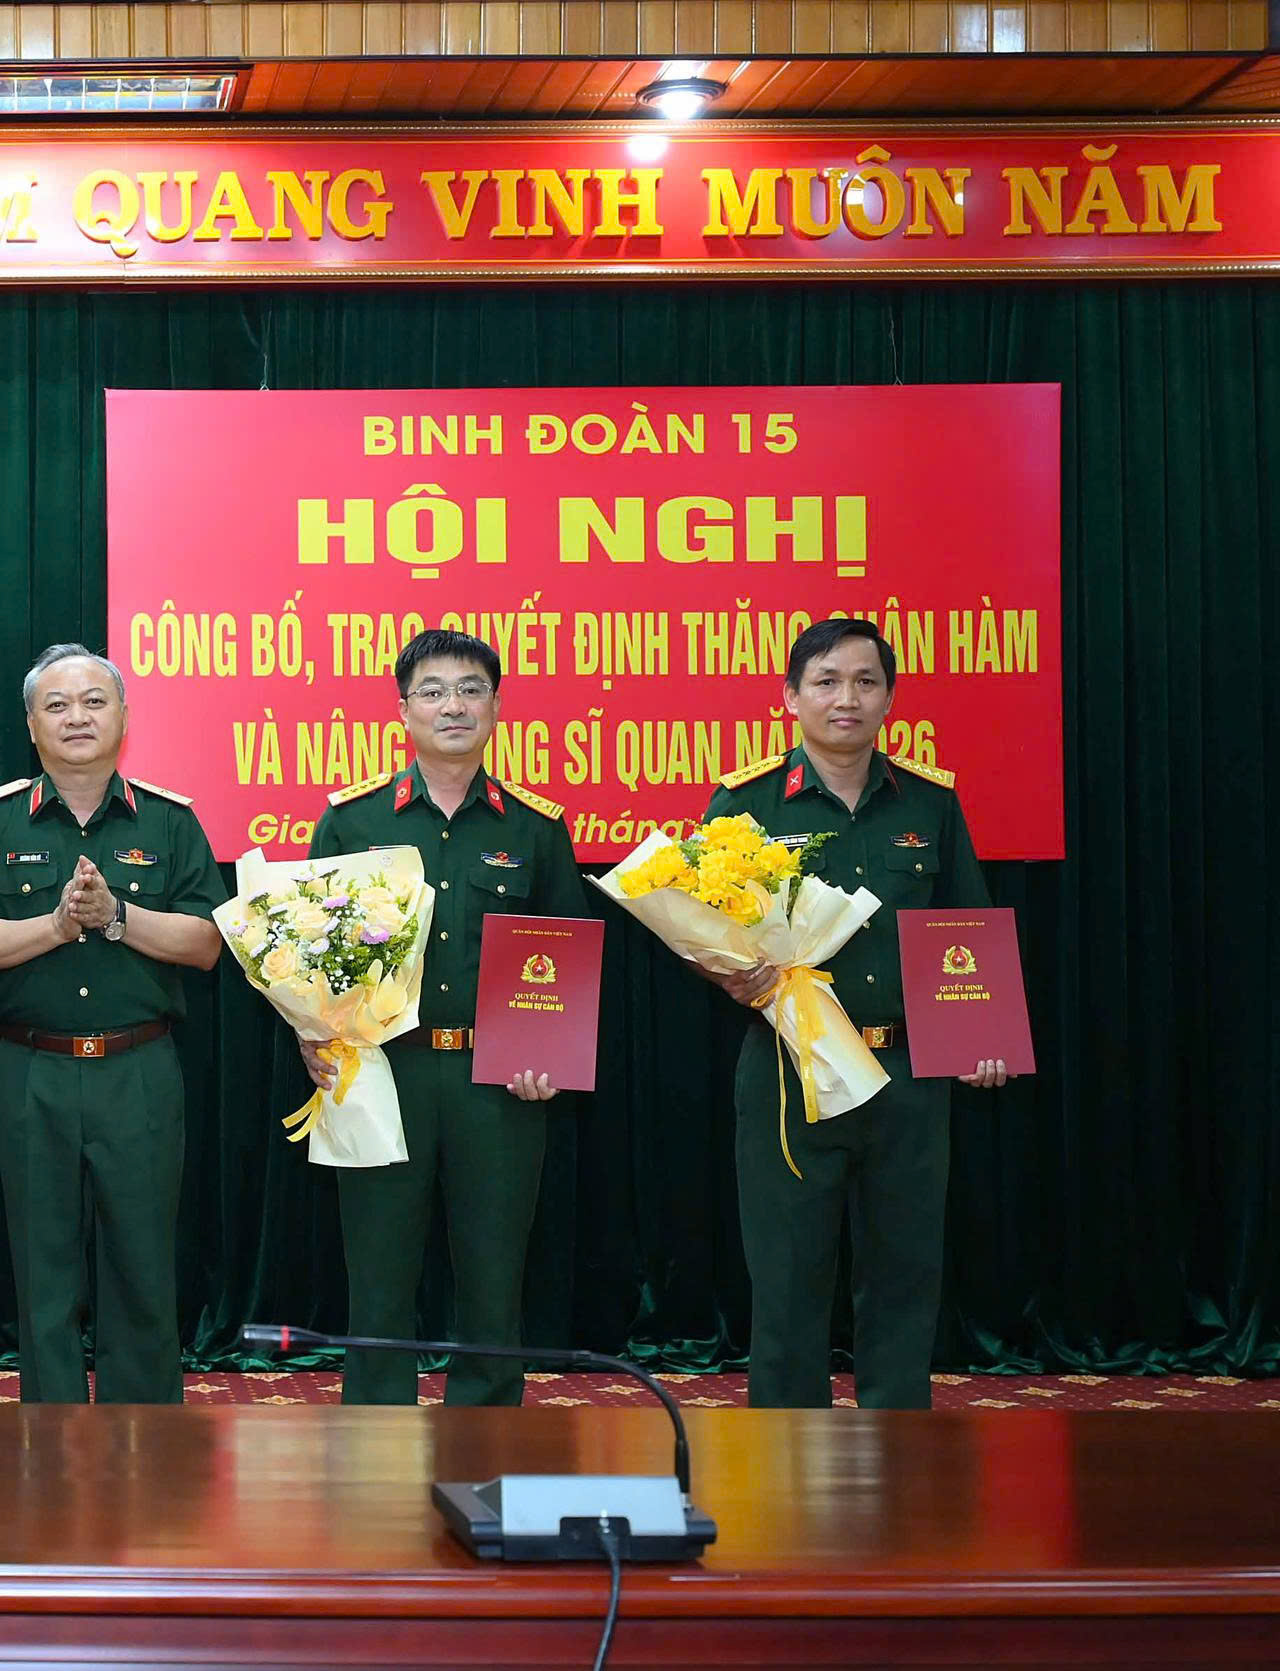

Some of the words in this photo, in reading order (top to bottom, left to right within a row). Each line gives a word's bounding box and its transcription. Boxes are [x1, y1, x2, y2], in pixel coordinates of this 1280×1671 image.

[71, 168, 394, 258] QUANG
[421, 168, 665, 238] VINH
[701, 144, 972, 237] MUÔN
[1003, 143, 1223, 234] NĂM
[363, 415, 503, 456] BINH
[525, 402, 705, 455] ĐOÀN
[731, 413, 798, 454] 15
[298, 483, 507, 579] HỘI
[559, 495, 867, 577] NGHỊ
[130, 600, 237, 678] CÔNG
[251, 590, 316, 685] BỐ,
[440, 591, 561, 676] YẾT
[573, 611, 668, 689] ĐỊNH
[828, 596, 935, 674] ÂN
[949, 596, 1038, 673] HÀM
[233, 707, 283, 785] VÀ
[297, 708, 407, 785] NÂNG
[564, 707, 604, 785] SĨ
[616, 719, 720, 793] QUAN
[247, 813, 316, 845] Gia
